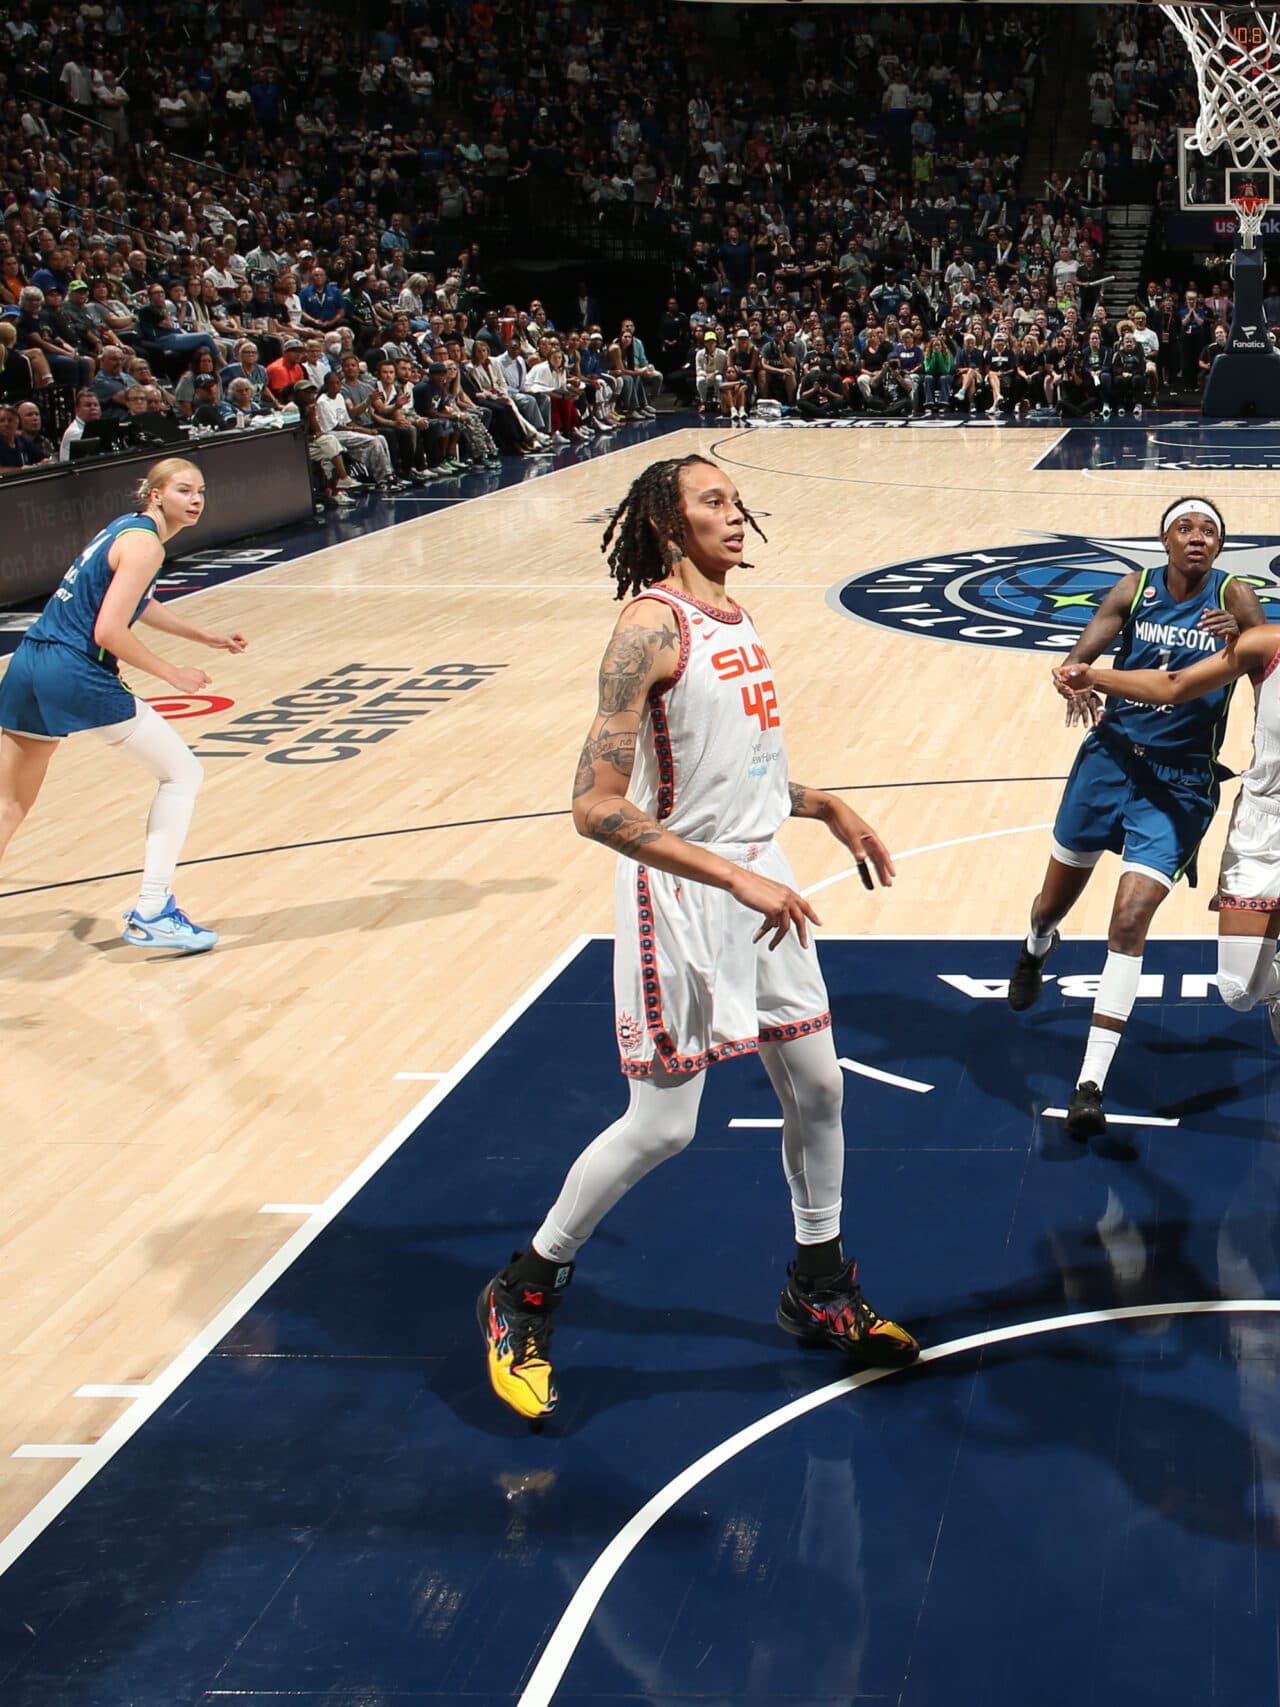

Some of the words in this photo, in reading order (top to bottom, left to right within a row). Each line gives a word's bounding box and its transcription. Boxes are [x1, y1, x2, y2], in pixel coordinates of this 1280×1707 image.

[1232, 339, 1265, 349] Fanatics
[866, 553, 1019, 593] LYNX
[1135, 620, 1217, 652] MINNESOTA
[264, 663, 510, 765] CENTER
[741, 680, 780, 732] 42
